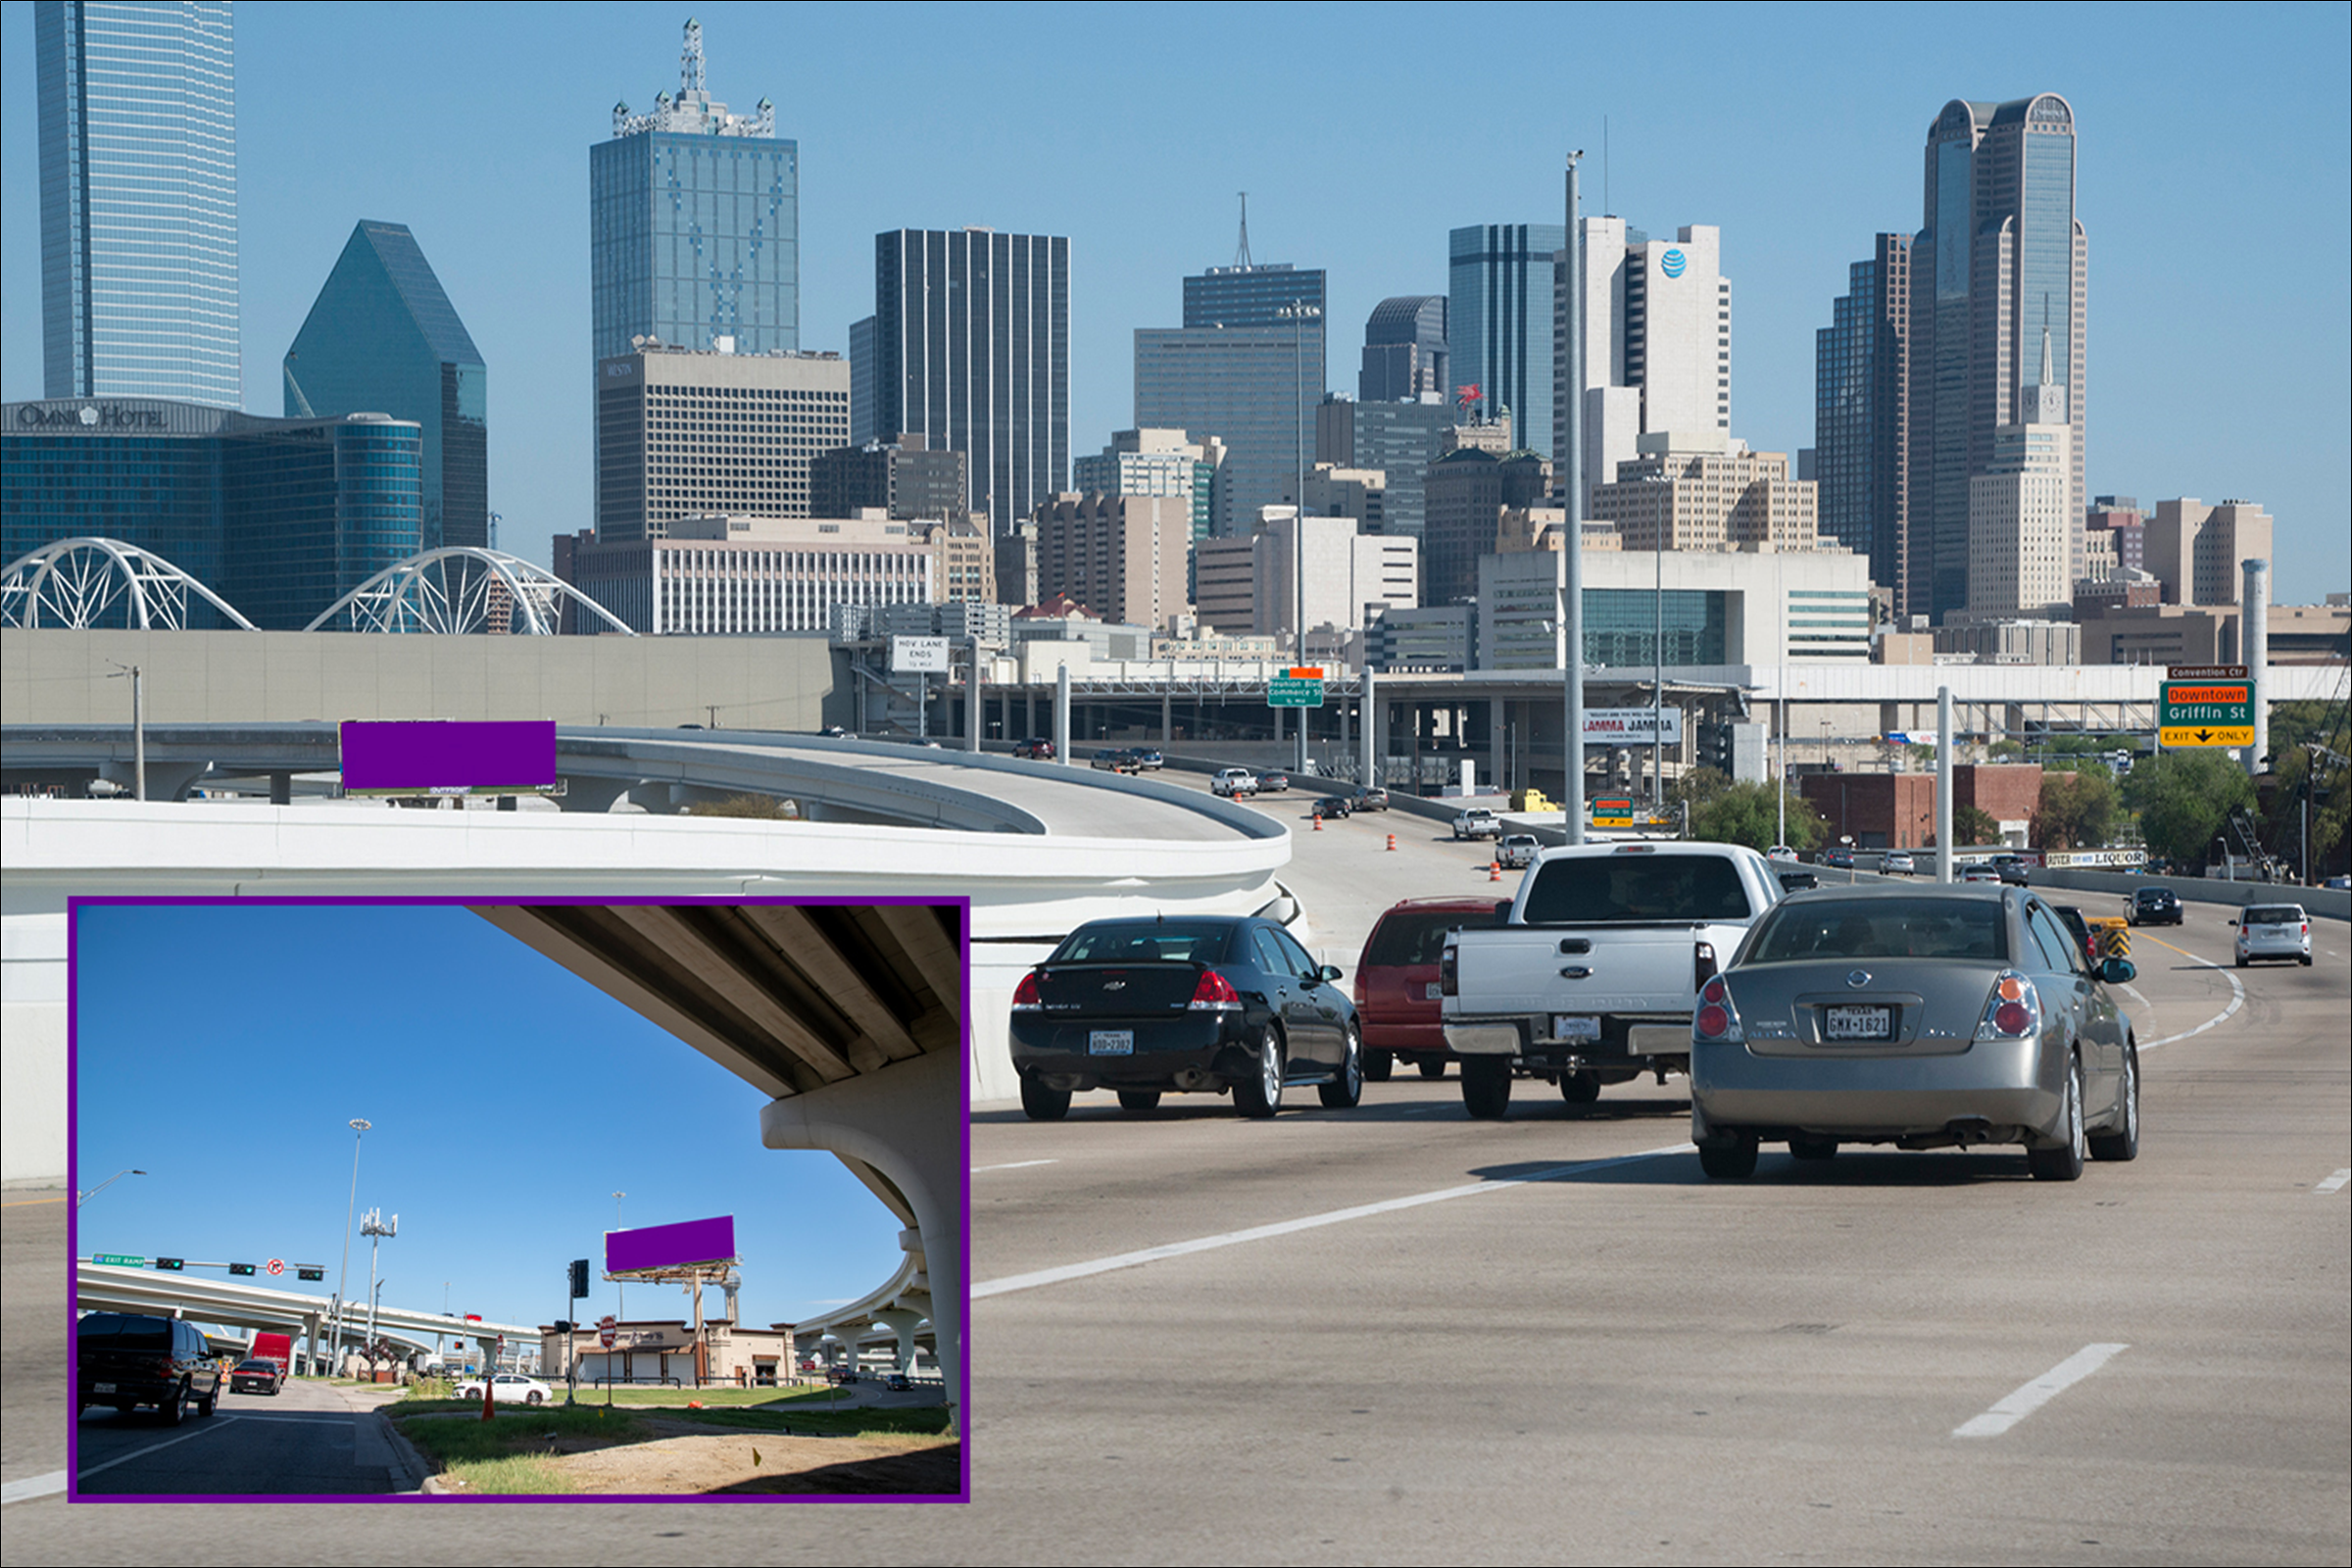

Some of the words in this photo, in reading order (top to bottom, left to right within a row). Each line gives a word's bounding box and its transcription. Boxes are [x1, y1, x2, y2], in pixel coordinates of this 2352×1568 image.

[19, 403, 80, 426] OMNI
[102, 405, 169, 427] HOTEL
[2172, 667, 2227, 677] Convention
[2229, 667, 2244, 677] Ctr
[2170, 689, 2245, 701] Downtown
[2169, 706, 2223, 719] Griffin
[2230, 706, 2245, 719] St
[1583, 720, 1625, 732] LAMMA
[2164, 731, 2189, 741] EXIT
[2217, 731, 2249, 741] ONLY
[2095, 851, 2144, 866] LIQUOR
